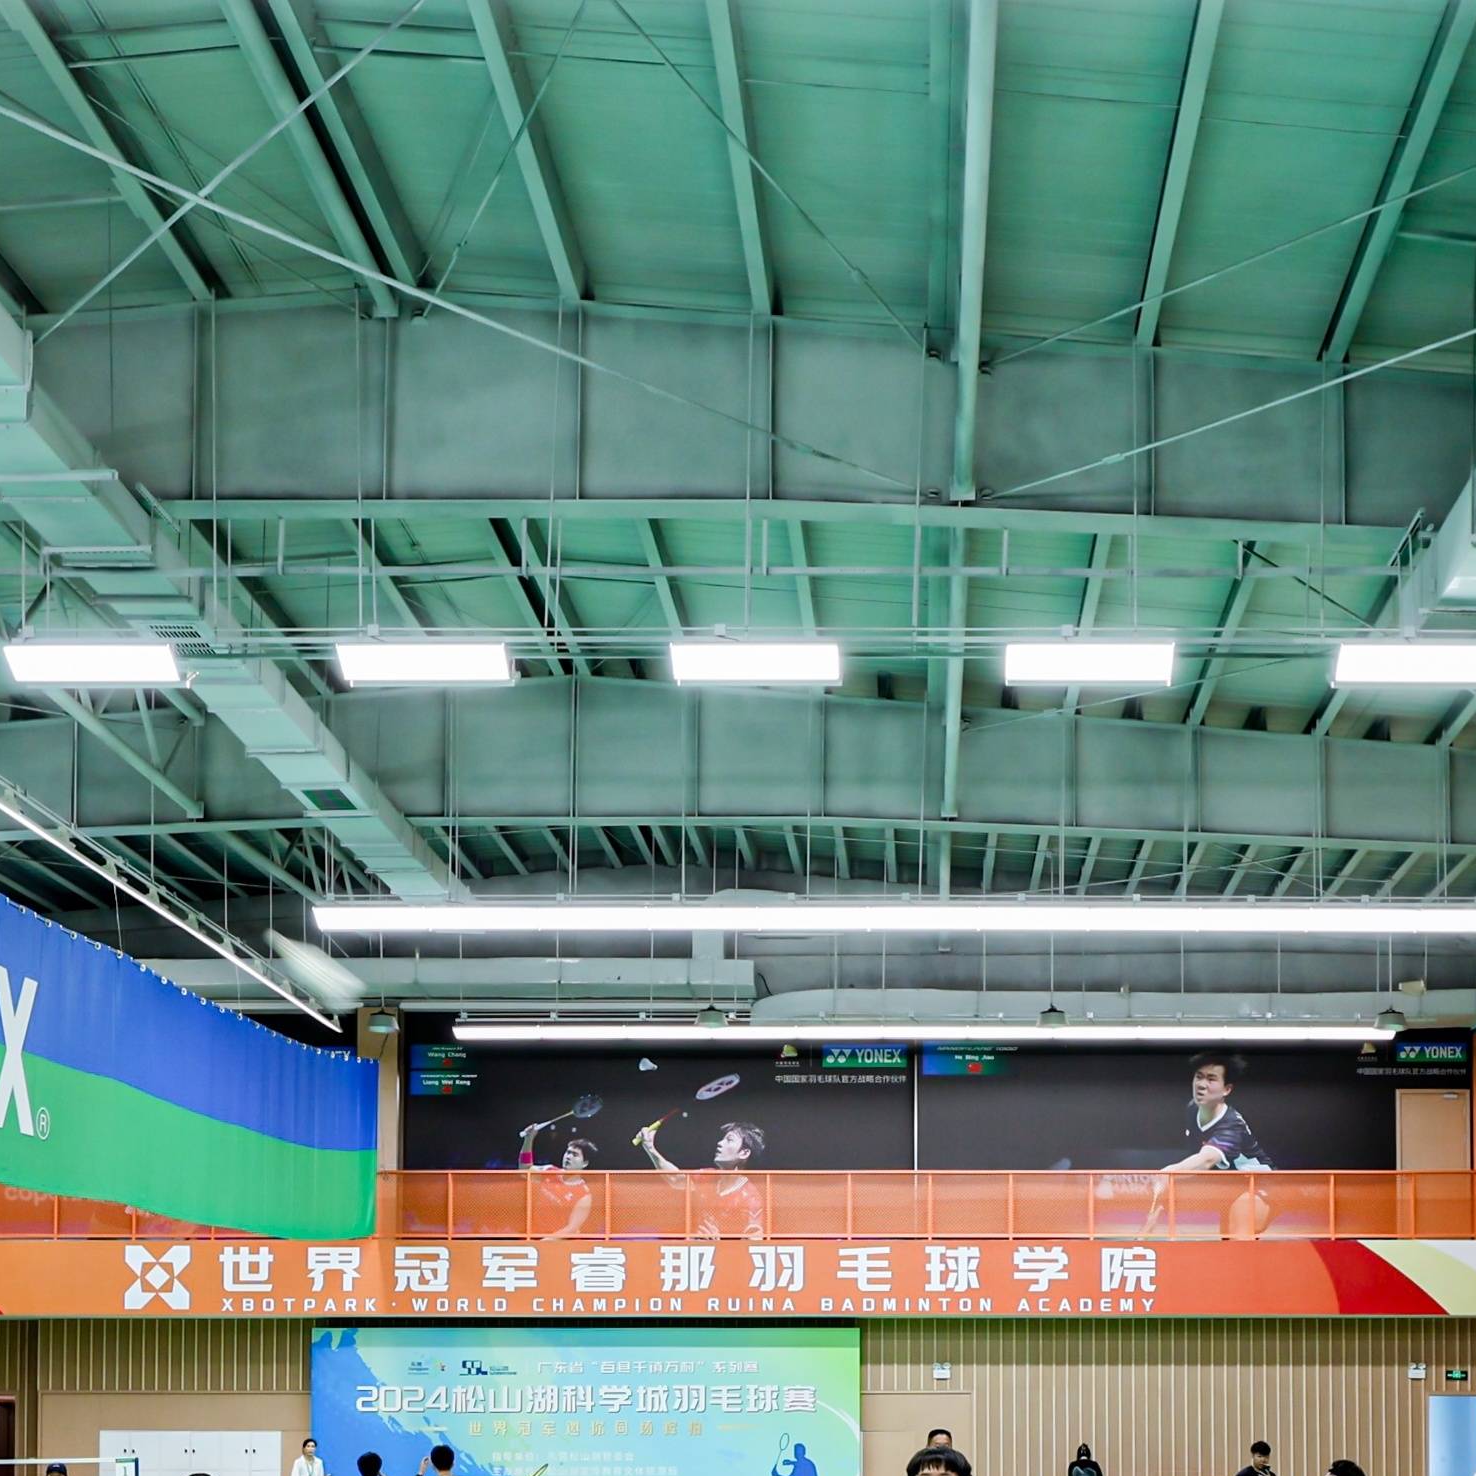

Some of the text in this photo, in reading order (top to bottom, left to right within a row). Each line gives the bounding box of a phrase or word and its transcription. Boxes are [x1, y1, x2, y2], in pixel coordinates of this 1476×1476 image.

[855, 1048, 902, 1063] YONEX
[1423, 1046, 1463, 1059] YONEX
[218, 1245, 1158, 1293] 世界冠军睿那羽毛球学院
[221, 1297, 1156, 1312] XBOTPARK WORLD CHAMPION RUINA BADMINTON ACADEMY
[355, 1384, 818, 1414] 2024松山湖科学城羽毛球赛
